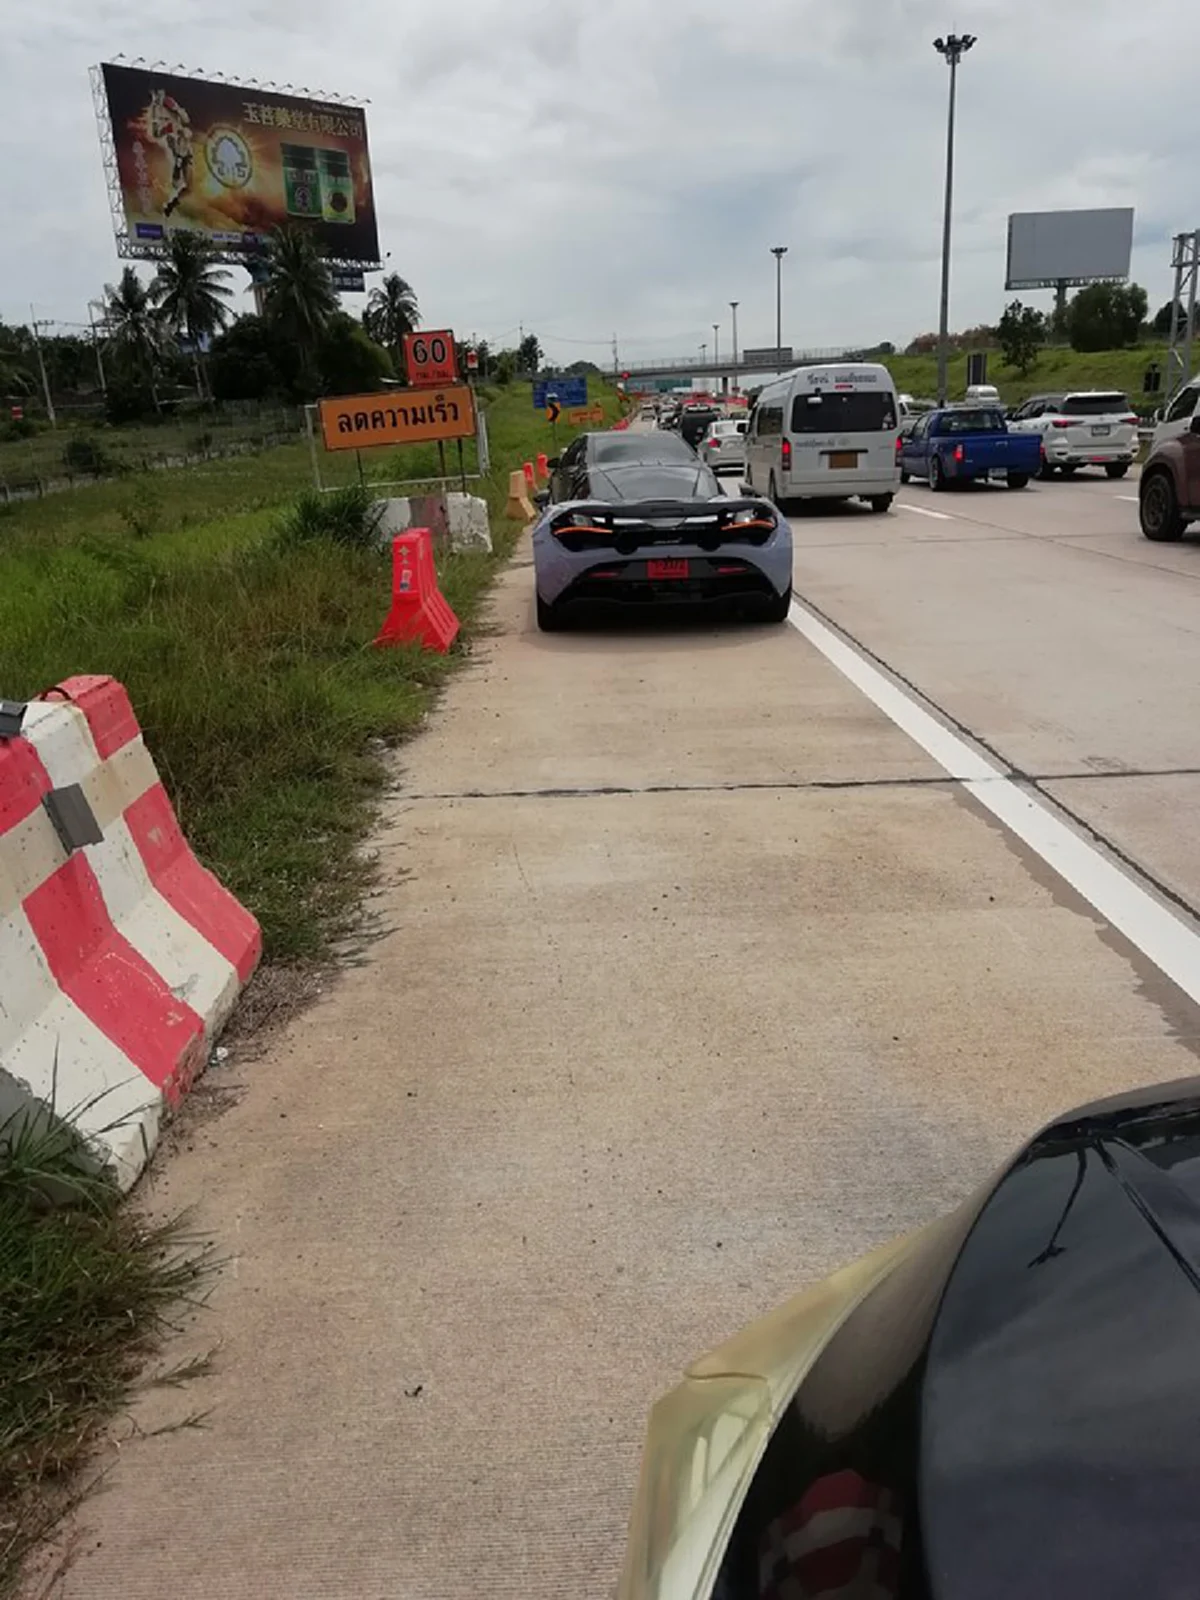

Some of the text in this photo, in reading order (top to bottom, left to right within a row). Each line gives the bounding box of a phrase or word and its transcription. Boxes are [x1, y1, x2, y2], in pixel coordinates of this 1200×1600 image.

[413, 338, 446, 364] 60
[337, 394, 460, 433] ลดความเร็ว
